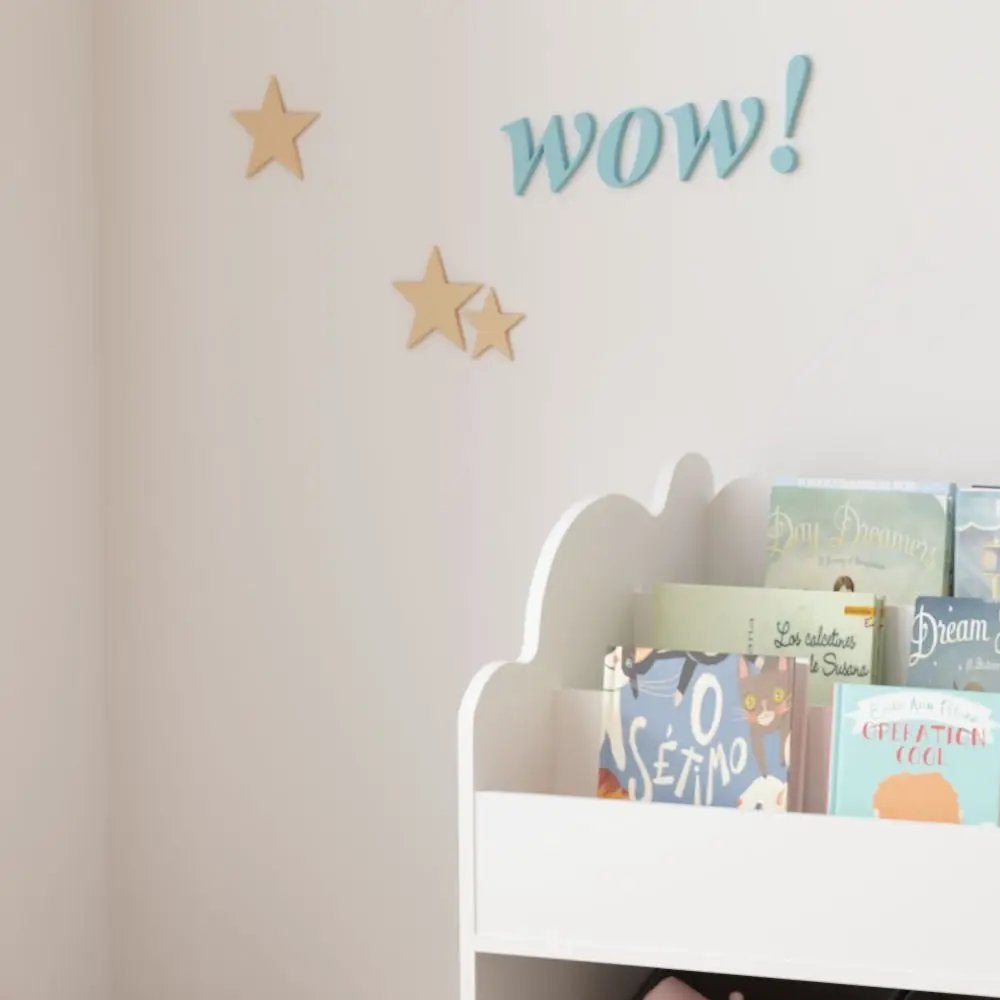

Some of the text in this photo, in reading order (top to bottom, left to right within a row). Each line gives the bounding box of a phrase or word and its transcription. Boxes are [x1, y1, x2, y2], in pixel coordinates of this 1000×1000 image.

[500, 53, 812, 196] wow!
[767, 504, 820, 556] Day
[774, 620, 801, 649] Los
[909, 604, 991, 668] Dream
[821, 652, 870, 677] Susana
[690, 672, 723, 746] O
